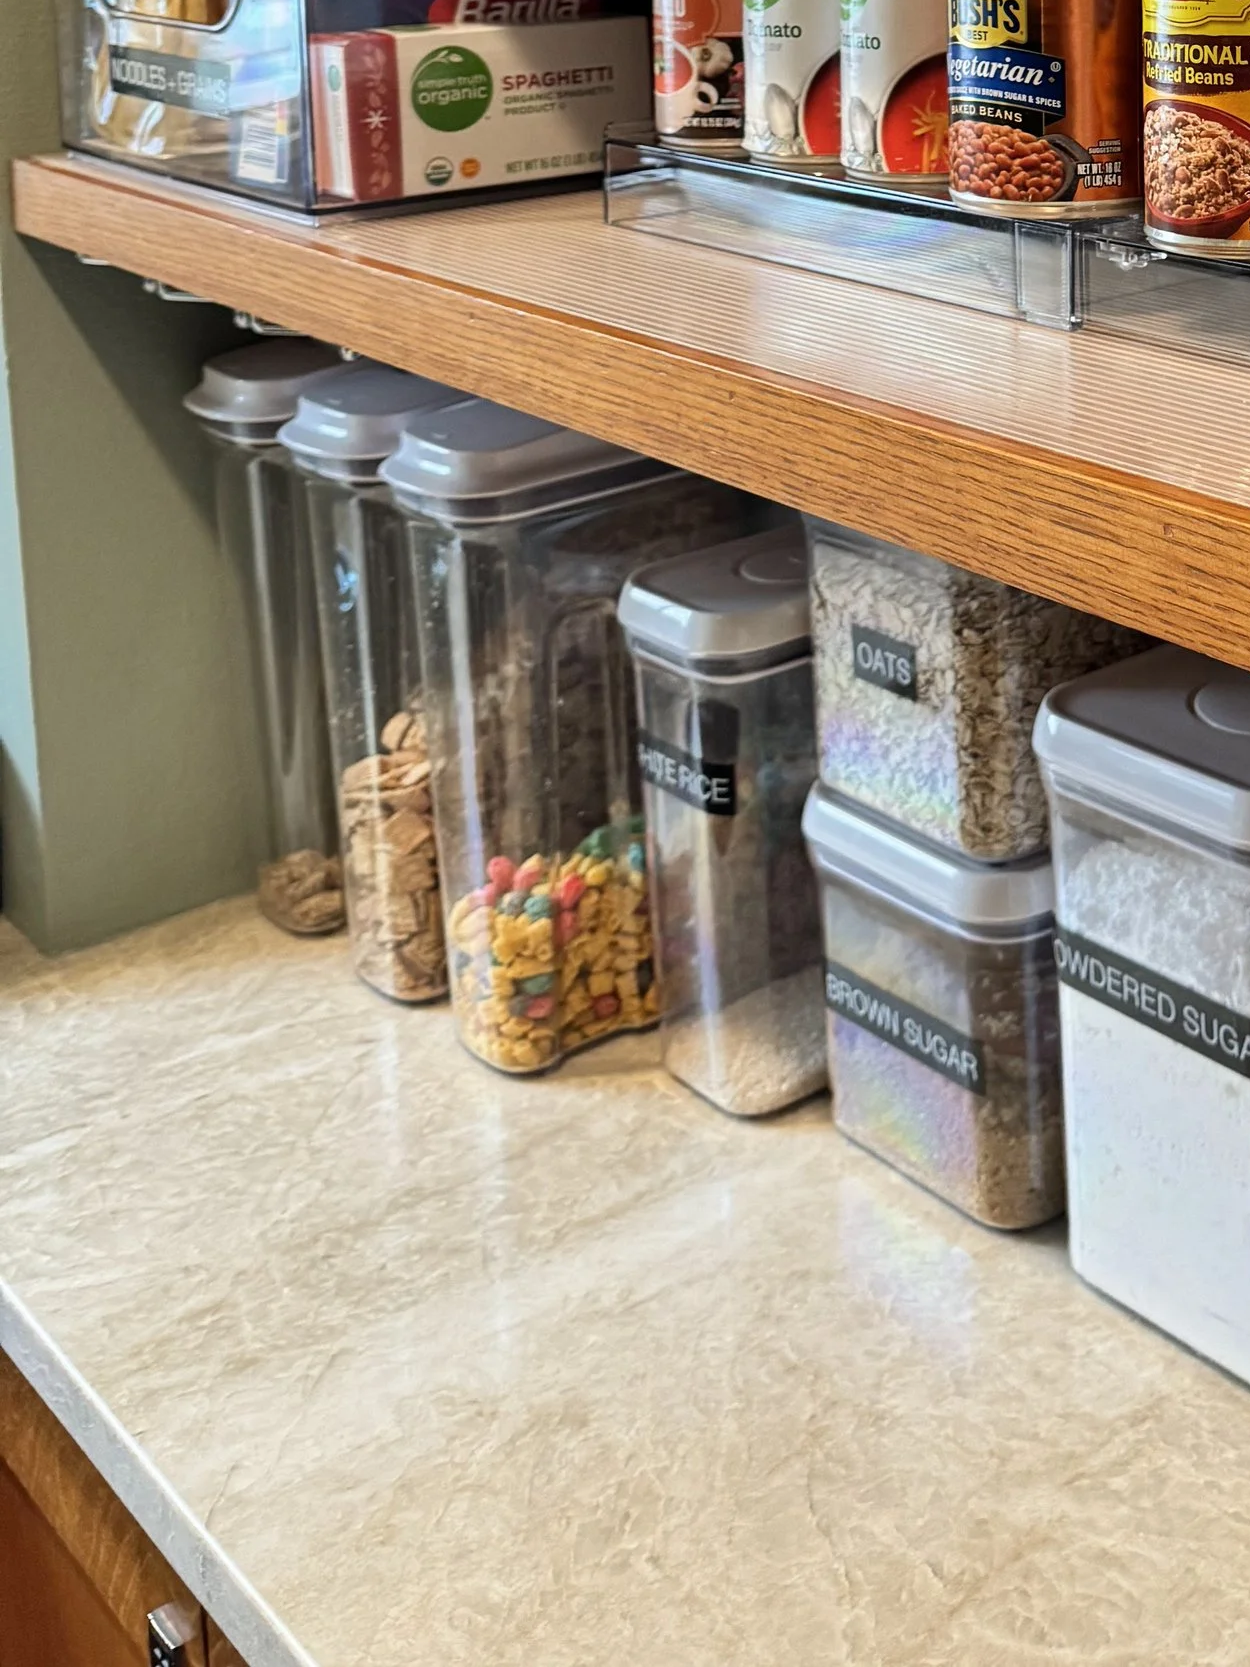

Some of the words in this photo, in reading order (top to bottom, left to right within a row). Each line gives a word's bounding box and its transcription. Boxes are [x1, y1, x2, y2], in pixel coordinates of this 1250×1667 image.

[966, 29, 989, 42] BEST
[1142, 40, 1249, 66] TRADITIONAL
[111, 57, 167, 92] NOODLES
[456, 73, 488, 86] truth
[501, 65, 615, 92] SPAGHETTI
[948, 54, 1044, 87] egetarian
[1146, 59, 1183, 85] Refried
[1184, 64, 1235, 86] Beans
[417, 83, 489, 106] organic
[503, 92, 553, 106] ORGANIC
[556, 84, 616, 100] SPAGHETTI
[1004, 90, 1028, 103] SUGAR
[1035, 95, 1062, 110] SPICES
[503, 103, 556, 117] PRODUCT
[951, 103, 976, 116] BAKED
[979, 105, 1024, 123] BEANS
[505, 159, 523, 175] NET
[855, 640, 912, 685] OATS
[825, 970, 899, 1036] BROWN
[902, 1015, 979, 1083] SUGAR
